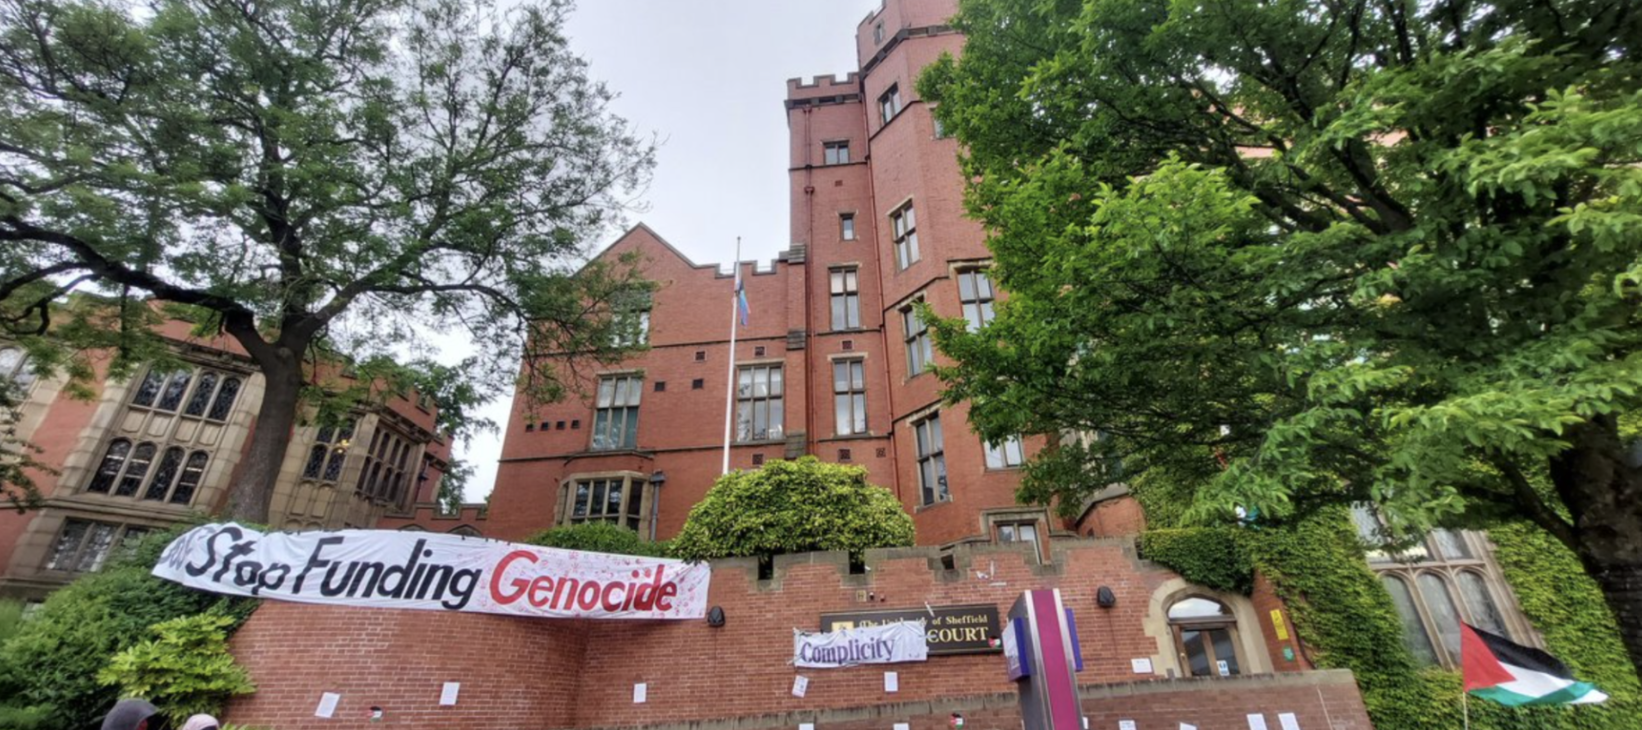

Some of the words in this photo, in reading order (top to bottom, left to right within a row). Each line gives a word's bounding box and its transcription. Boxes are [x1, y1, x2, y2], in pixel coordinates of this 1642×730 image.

[185, 526, 291, 596] Stop
[291, 535, 483, 610] Funding
[489, 550, 678, 612] Genocide
[932, 615, 942, 626] of
[946, 614, 988, 625] Sheffield
[927, 627, 988, 643] COURT
[801, 637, 895, 664] Complicity
